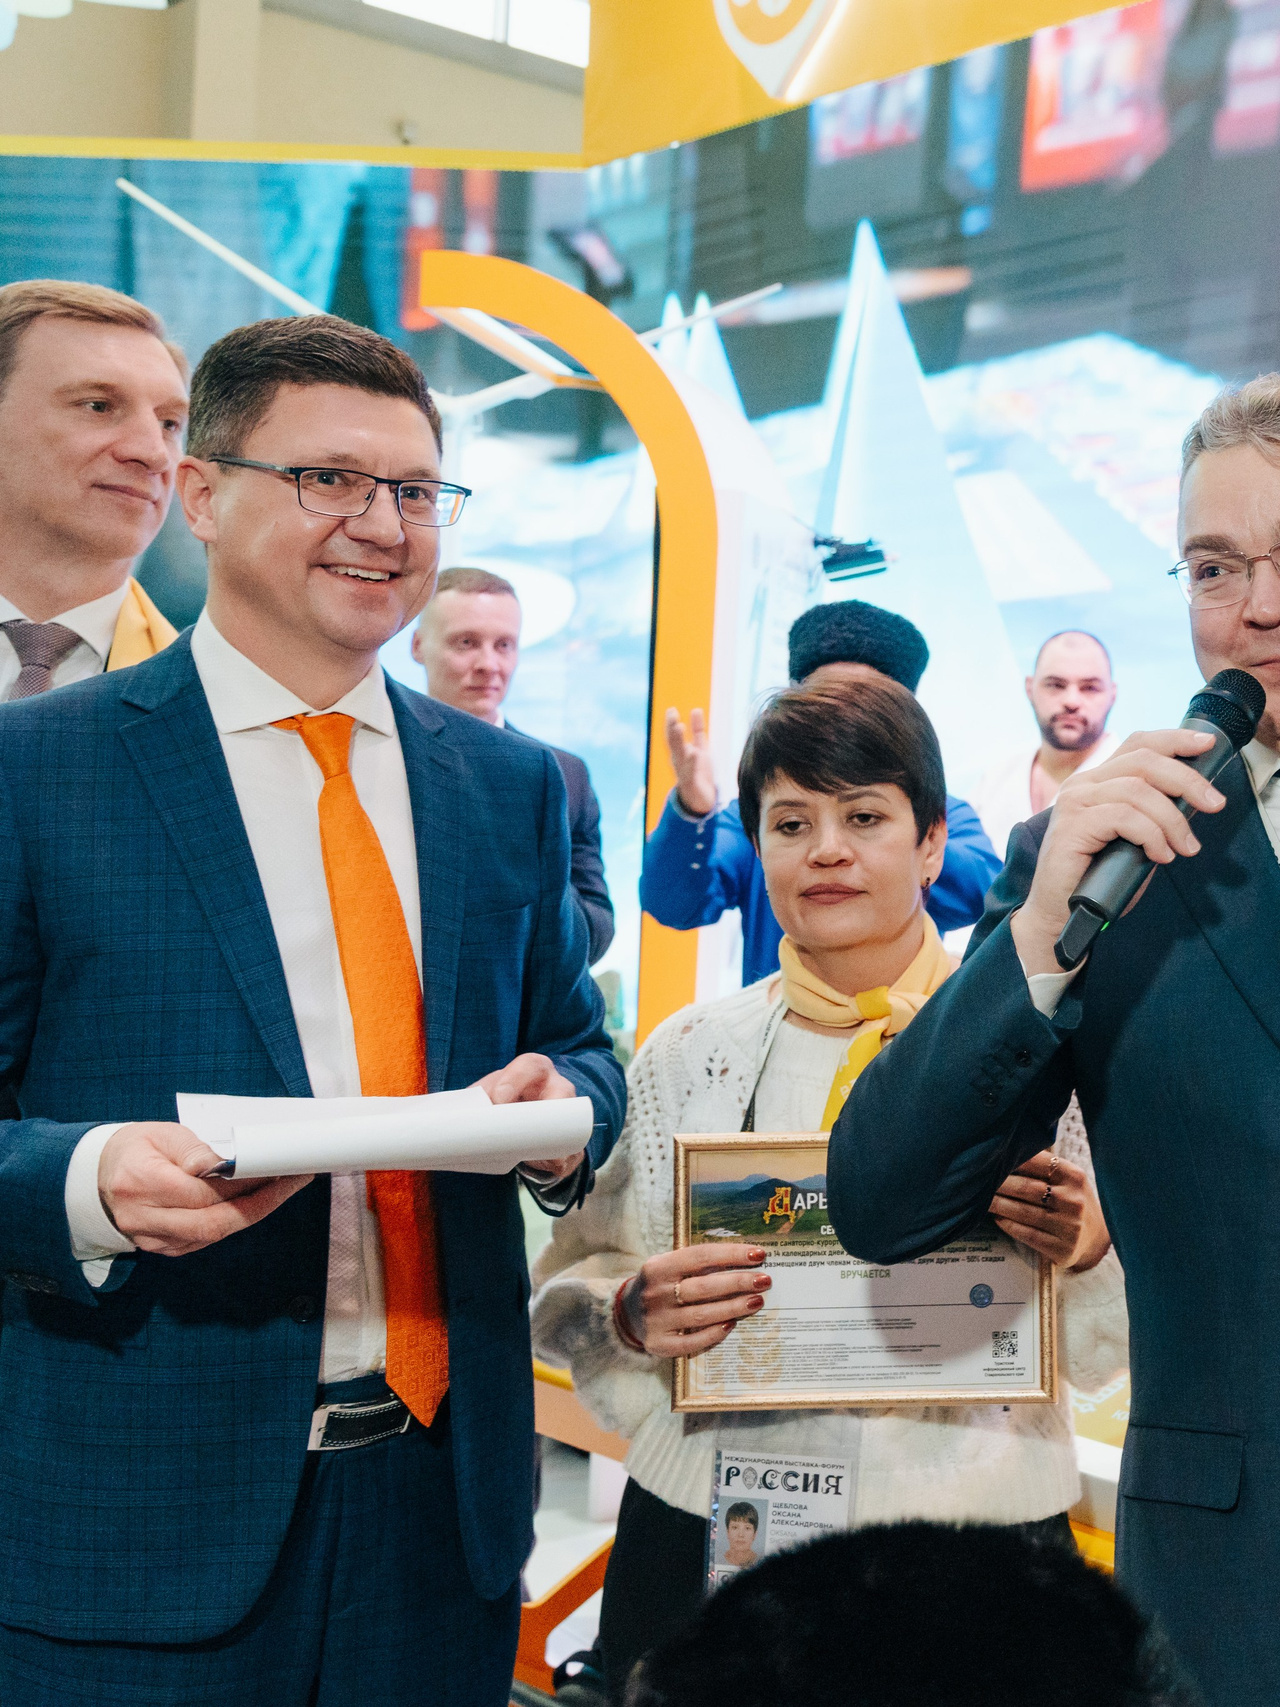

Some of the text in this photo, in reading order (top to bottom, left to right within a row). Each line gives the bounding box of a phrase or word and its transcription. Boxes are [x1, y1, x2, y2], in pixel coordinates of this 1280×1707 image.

[782, 1250, 827, 1258] календарных
[841, 1269, 891, 1279] ВРУЧАЕТСЯ
[724, 1456, 845, 1470] МЕЖДУНАРОДНАЯ ВЫСТАВКА-ФОРУМ
[723, 1466, 844, 1496] РОССИЯ
[772, 1502, 808, 1511] ЩЕБЛОВА
[771, 1510, 802, 1518] ОКСАНА
[770, 1519, 834, 1529] АЛЕКСАНДРОВНА
